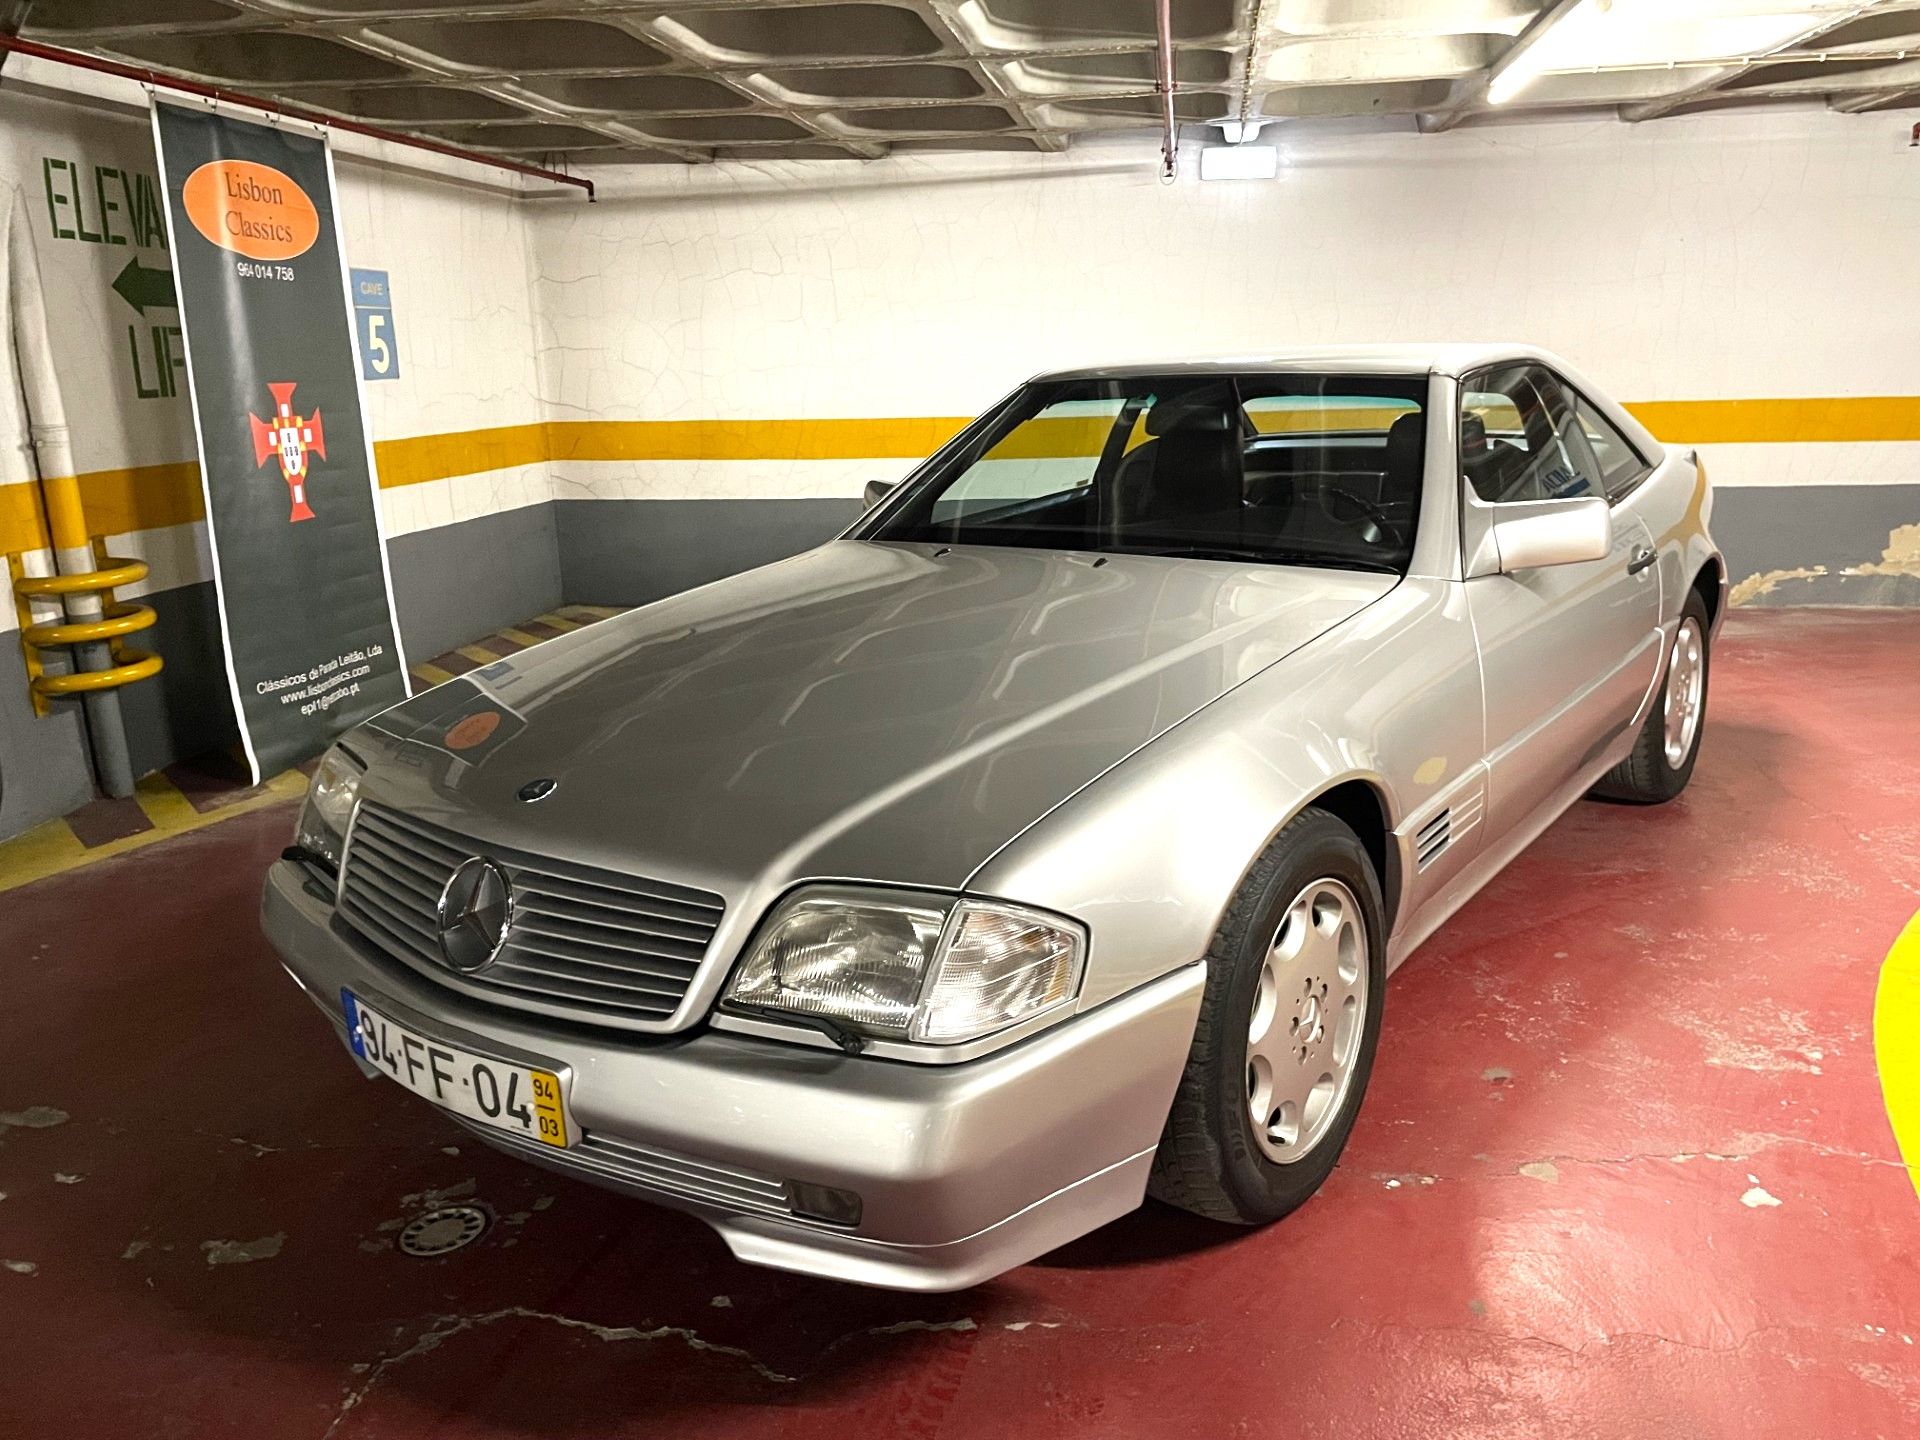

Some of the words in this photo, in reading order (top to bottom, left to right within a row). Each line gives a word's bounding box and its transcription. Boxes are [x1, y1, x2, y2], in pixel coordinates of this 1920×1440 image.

[225, 171, 283, 205] Lisbon
[225, 210, 293, 243] Classics
[254, 264, 273, 279] 014
[275, 266, 295, 281] 758
[360, 281, 384, 296] CAVE
[368, 315, 391, 374] 5
[256, 673, 307, 694] Clássicos
[366, 644, 383, 658] Lda
[533, 1078, 553, 1100] 94
[539, 1115, 559, 1137] 03
